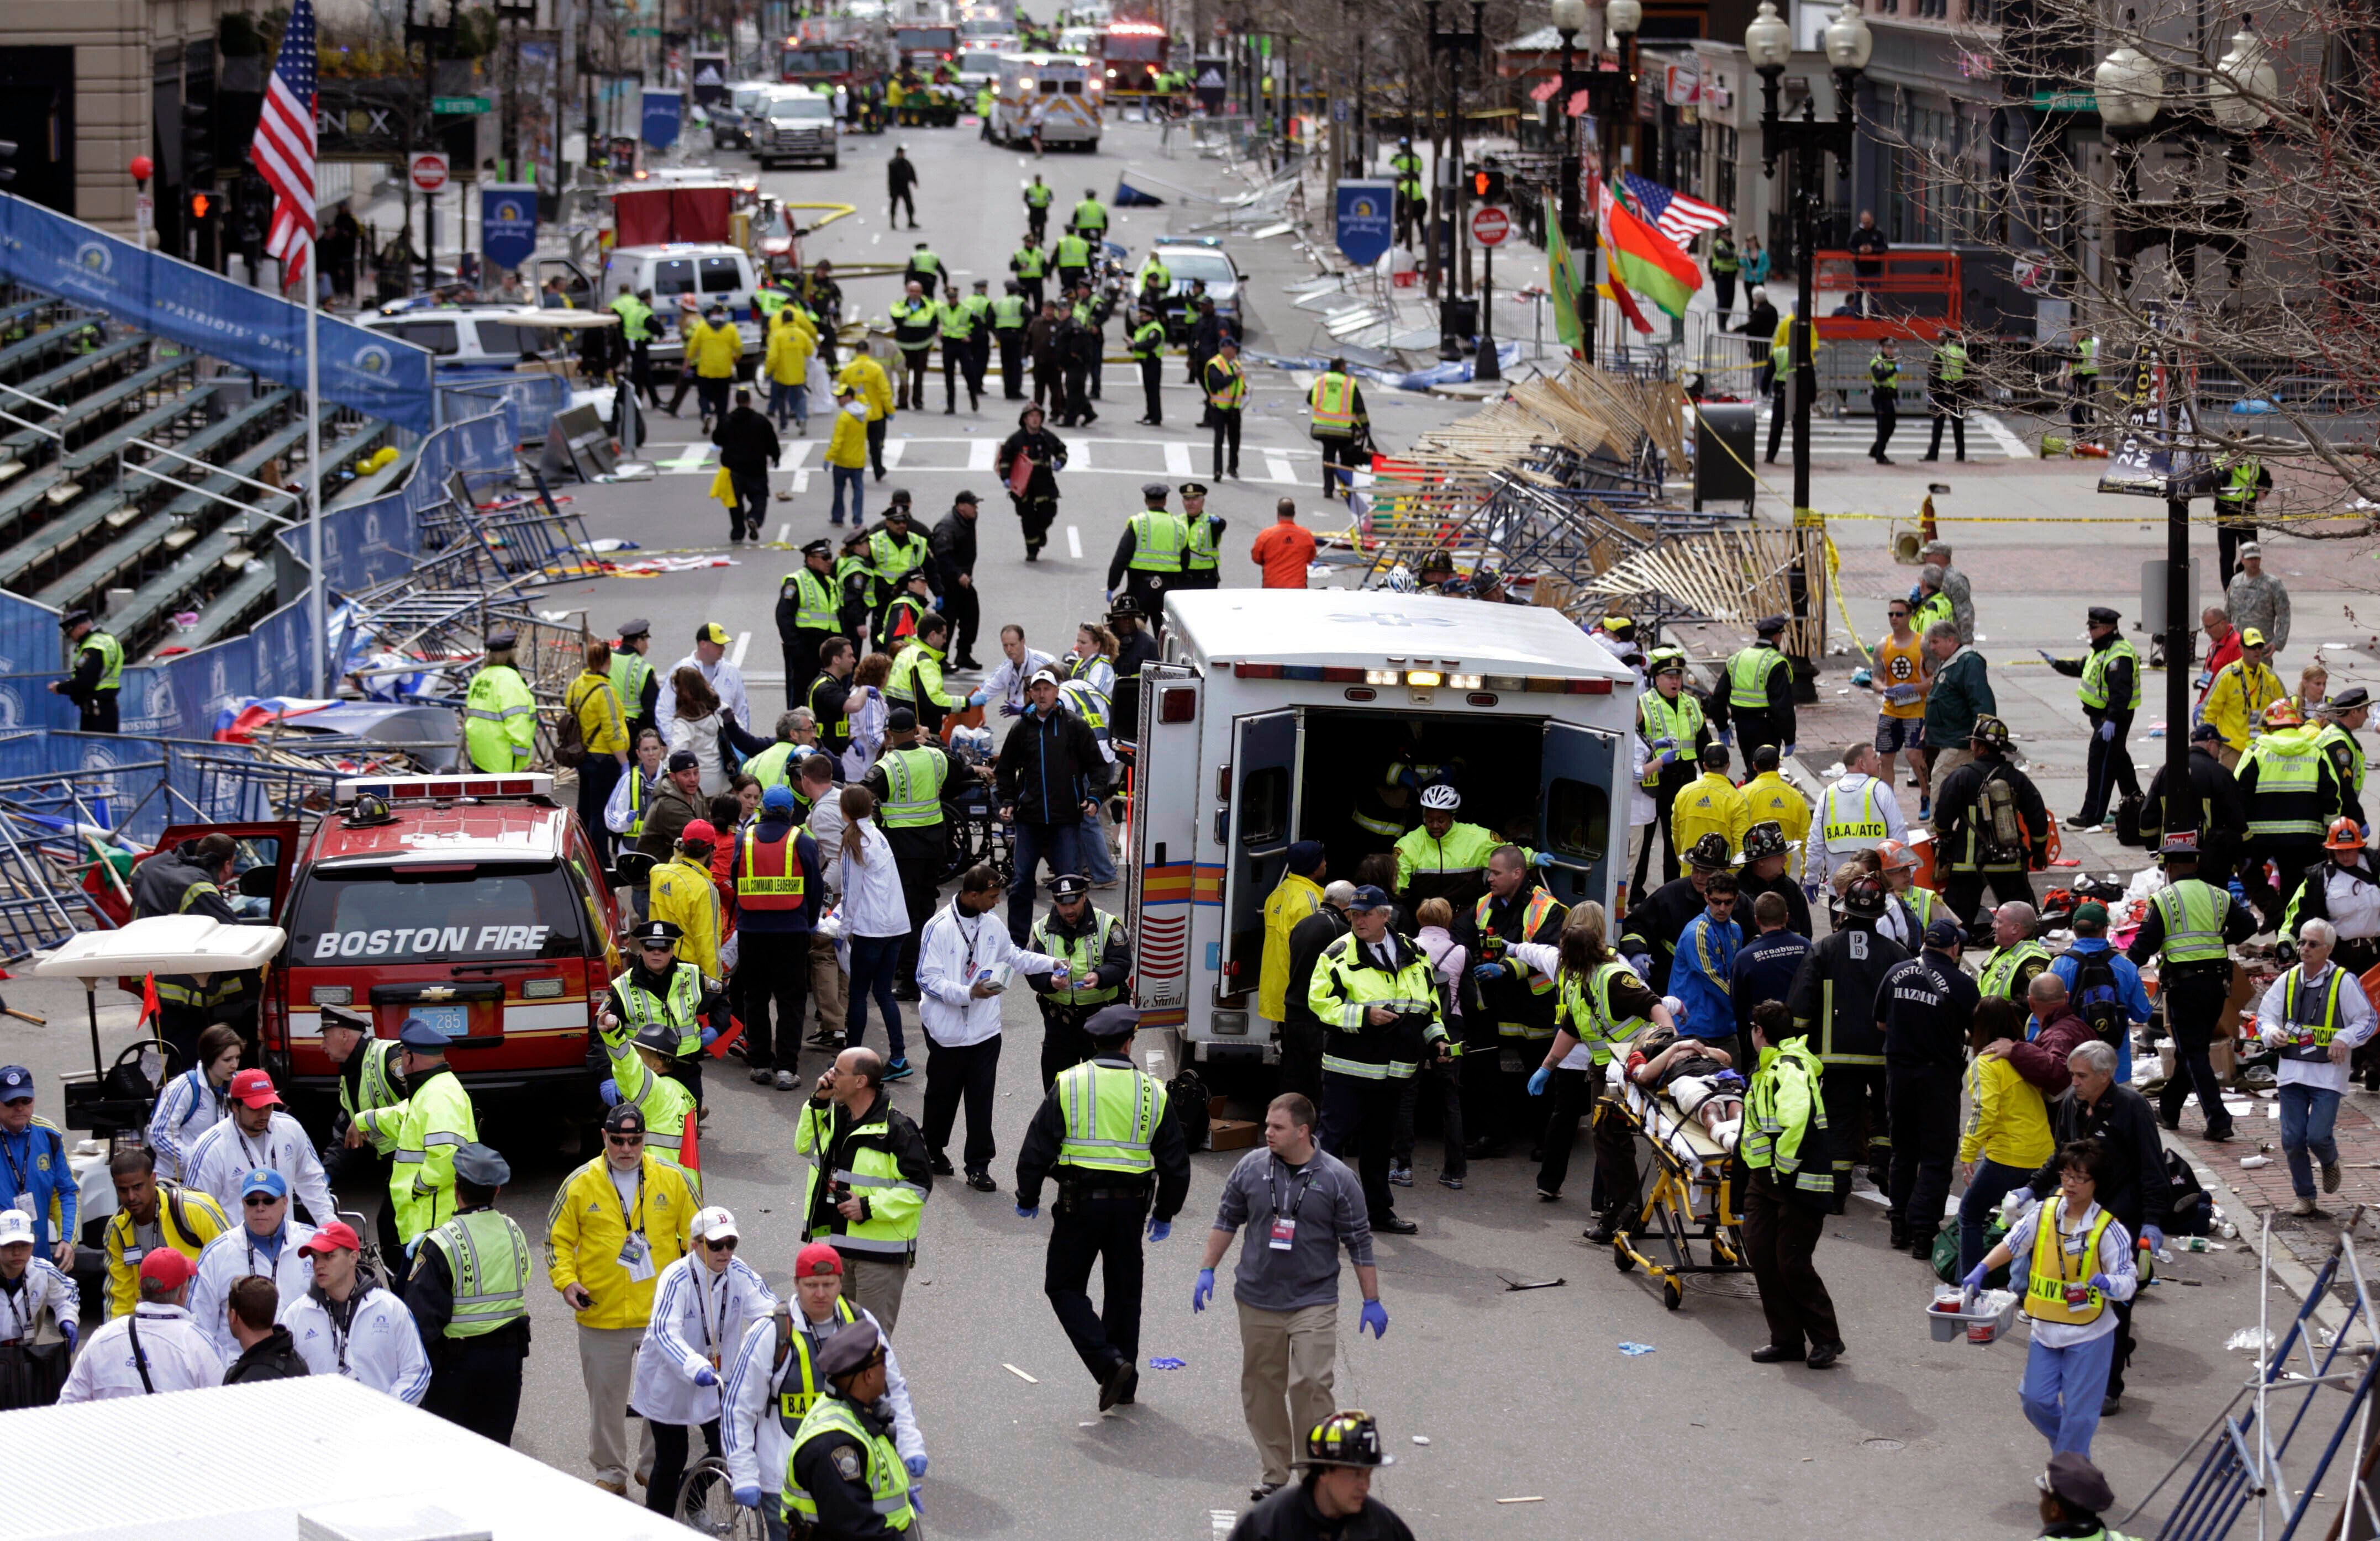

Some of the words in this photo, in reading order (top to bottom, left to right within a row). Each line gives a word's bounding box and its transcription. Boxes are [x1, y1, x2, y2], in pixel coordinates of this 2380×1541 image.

[258, 333, 294, 354] DAY
[2117, 414, 2144, 465] 203
[2135, 310, 2151, 405] BOSTN
[120, 719, 160, 732] BOSTON
[894, 762, 907, 799] BOSTON
[1775, 831, 1783, 845] 2
[1826, 824, 1882, 840] B.A.A./ATC
[751, 879, 773, 893] COMMAND
[775, 879, 801, 893] LEADERSHIP
[2166, 890, 2181, 923] OSTON
[2214, 889, 2223, 922] OLICE
[314, 927, 471, 959] BOSTON
[475, 925, 550, 951] FIRE
[1092, 932, 1101, 967] OLIC
[1752, 946, 1804, 960] Broadway
[1849, 931, 1869, 960] B
[1891, 965, 1925, 986] BOSTO
[1156, 992, 1183, 1008] Stand
[1894, 987, 1939, 1006] HAZMAT
[437, 1014, 461, 1029] 285
[371, 1054, 382, 1097] POLIC
[1140, 1078, 1151, 1131] POLICE
[716, 1213, 728, 1225] B
[449, 1226, 474, 1283] BOSTON
[512, 1225, 527, 1275] OLICE
[2045, 1281, 2057, 1299] IV
[2058, 1285, 2096, 1305] NSE
[125, 1359, 152, 1370] adas
[1363, 1431, 1376, 1453] 7
